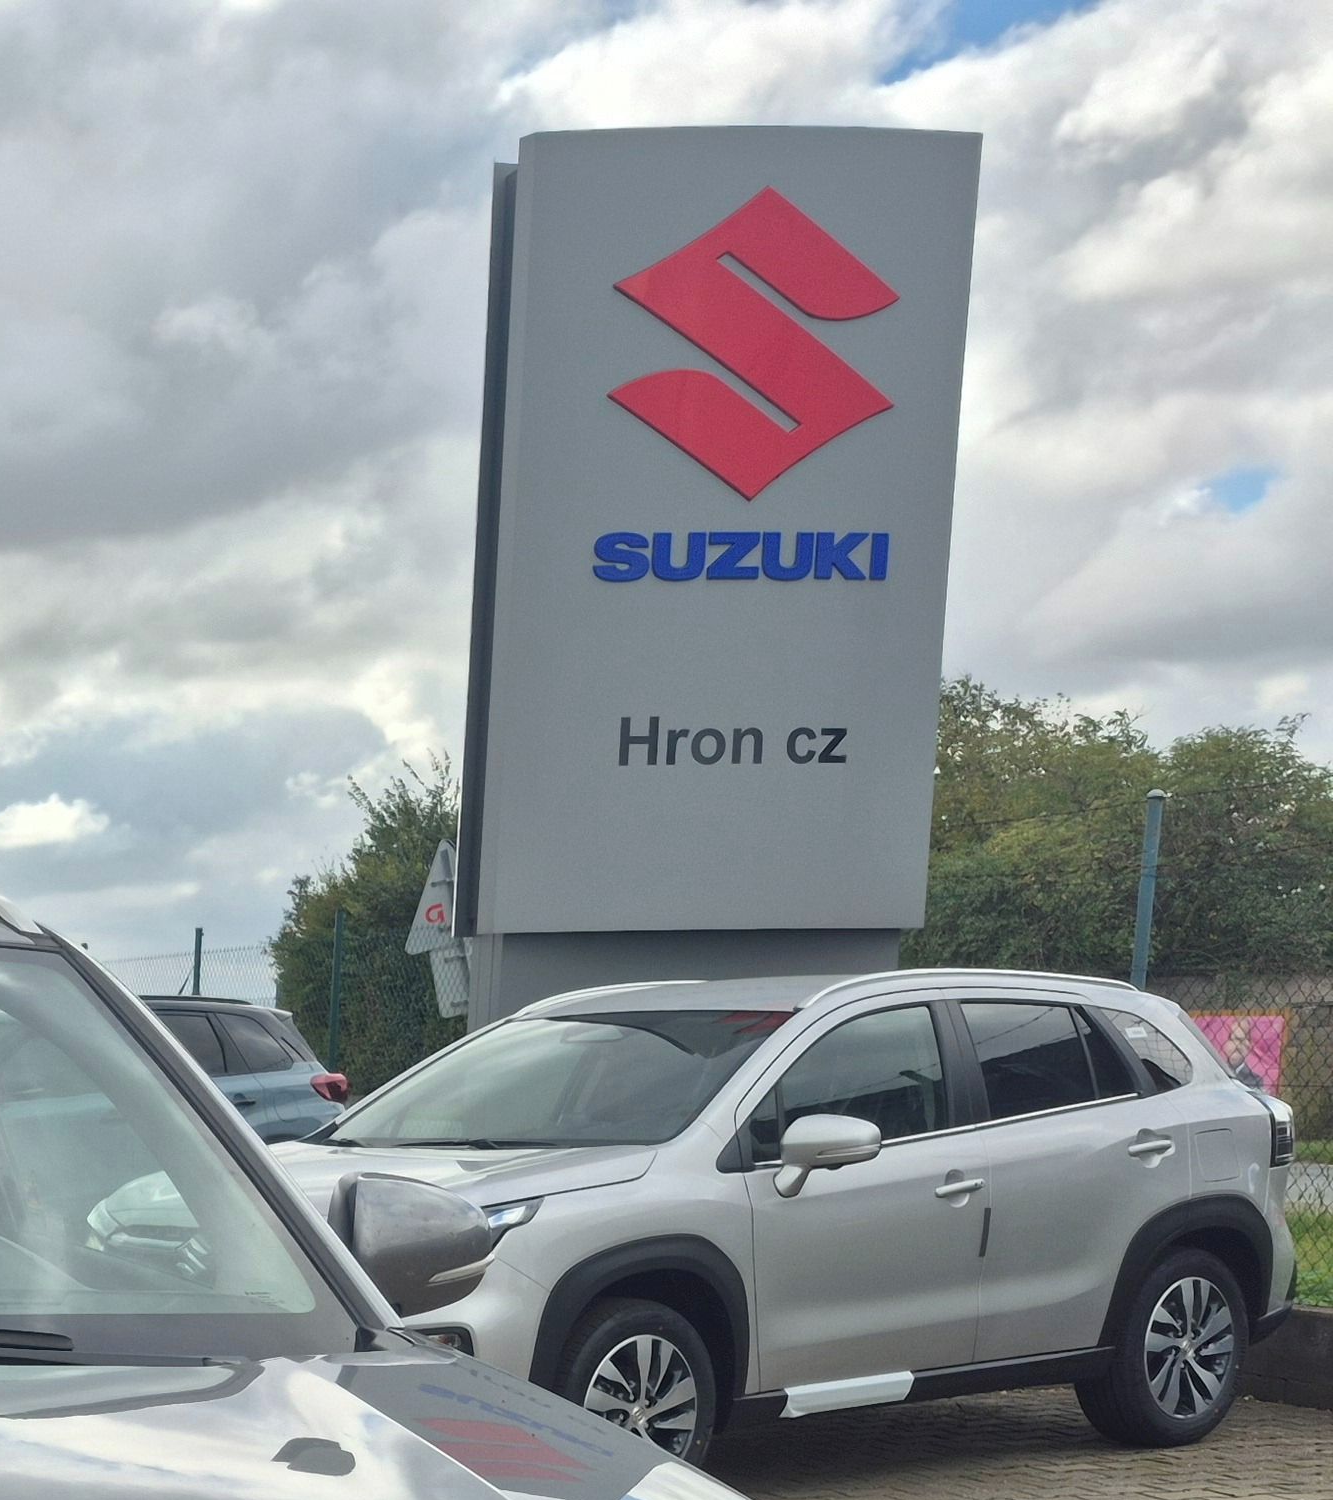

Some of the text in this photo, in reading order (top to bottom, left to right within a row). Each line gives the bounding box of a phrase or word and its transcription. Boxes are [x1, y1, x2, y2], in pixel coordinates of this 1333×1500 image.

[592, 531, 889, 582] SUZUKI
[618, 716, 848, 766] Hron cz
